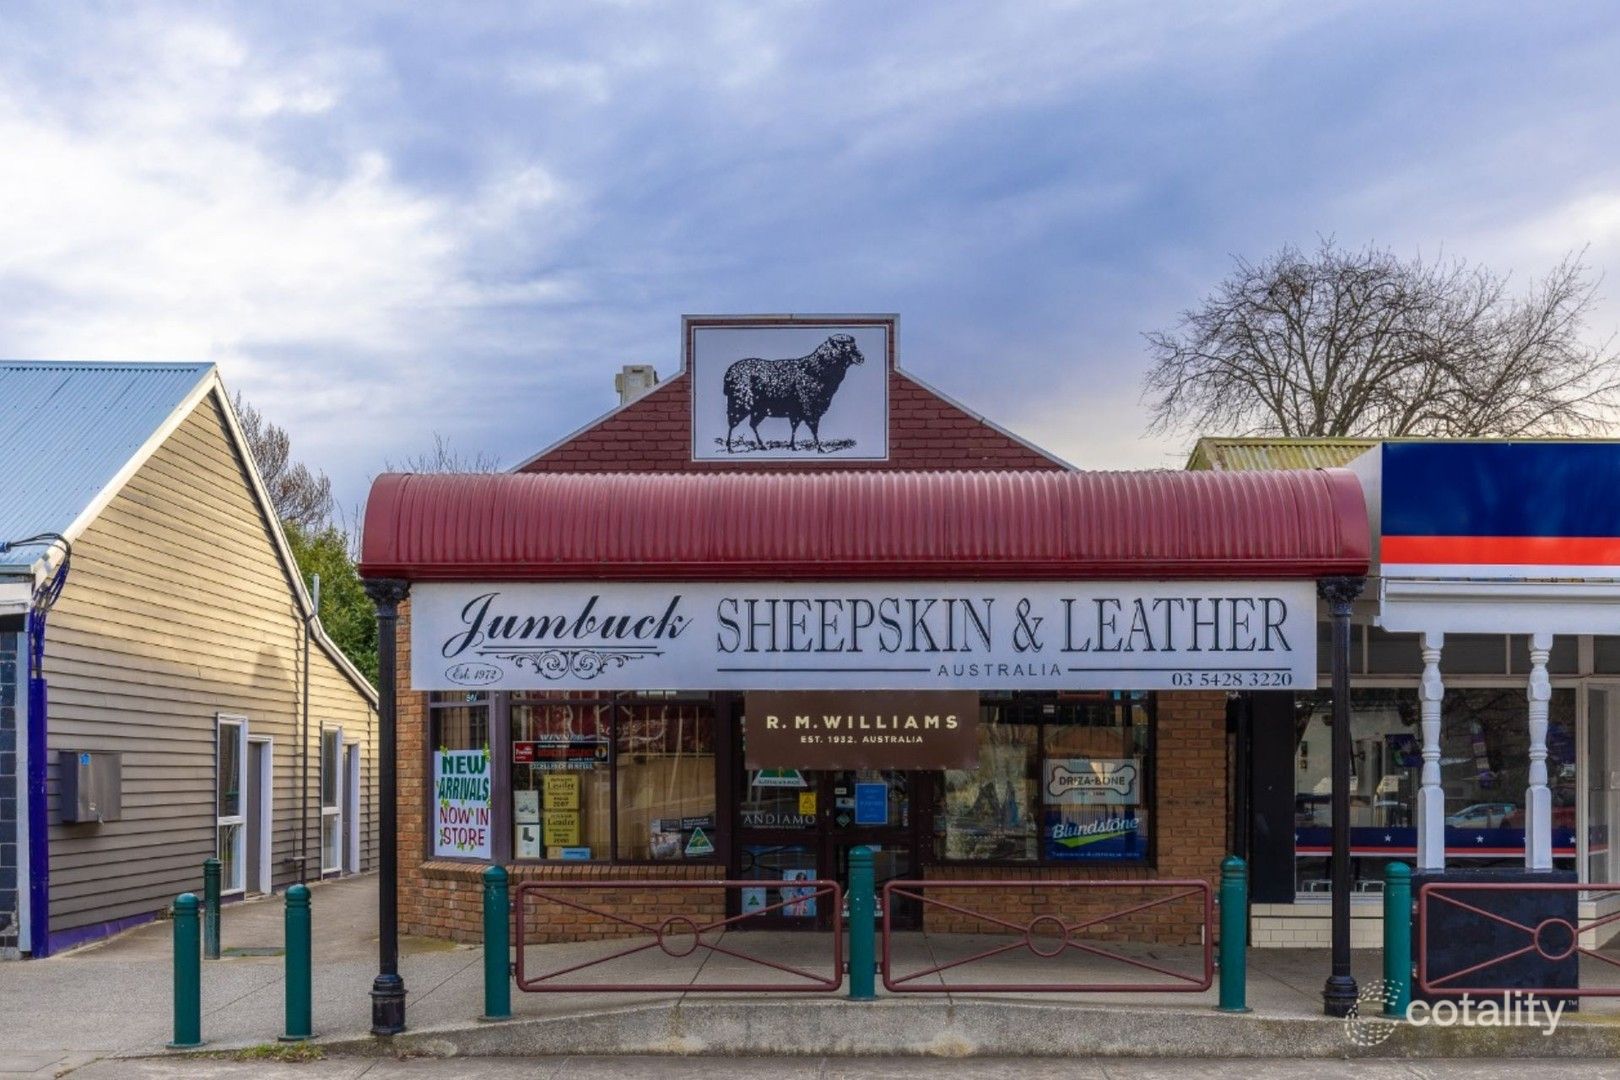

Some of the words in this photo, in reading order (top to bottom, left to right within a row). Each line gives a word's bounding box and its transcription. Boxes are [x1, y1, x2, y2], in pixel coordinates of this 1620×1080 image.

[441, 592, 692, 658] Jumbuck
[716, 597, 996, 653] SHEEPSKIN
[1012, 597, 1044, 654] &
[1059, 597, 1293, 653] LEATHER
[938, 663, 1062, 677] AUSTRALIA
[1172, 672, 1193, 687] 03
[1200, 672, 1243, 687] 5428
[1249, 672, 1293, 687] 3220
[800, 735, 823, 744] EST.
[862, 735, 923, 744] AUSTRALIA
[442, 754, 486, 775] NEW
[438, 776, 489, 801] ARRIVALS
[440, 807, 470, 825] NOW
[476, 807, 489, 826] IN
[743, 814, 816, 825] ANDIAMO
[443, 827, 485, 846] STORE
[1052, 818, 1139, 839] Blundstone
